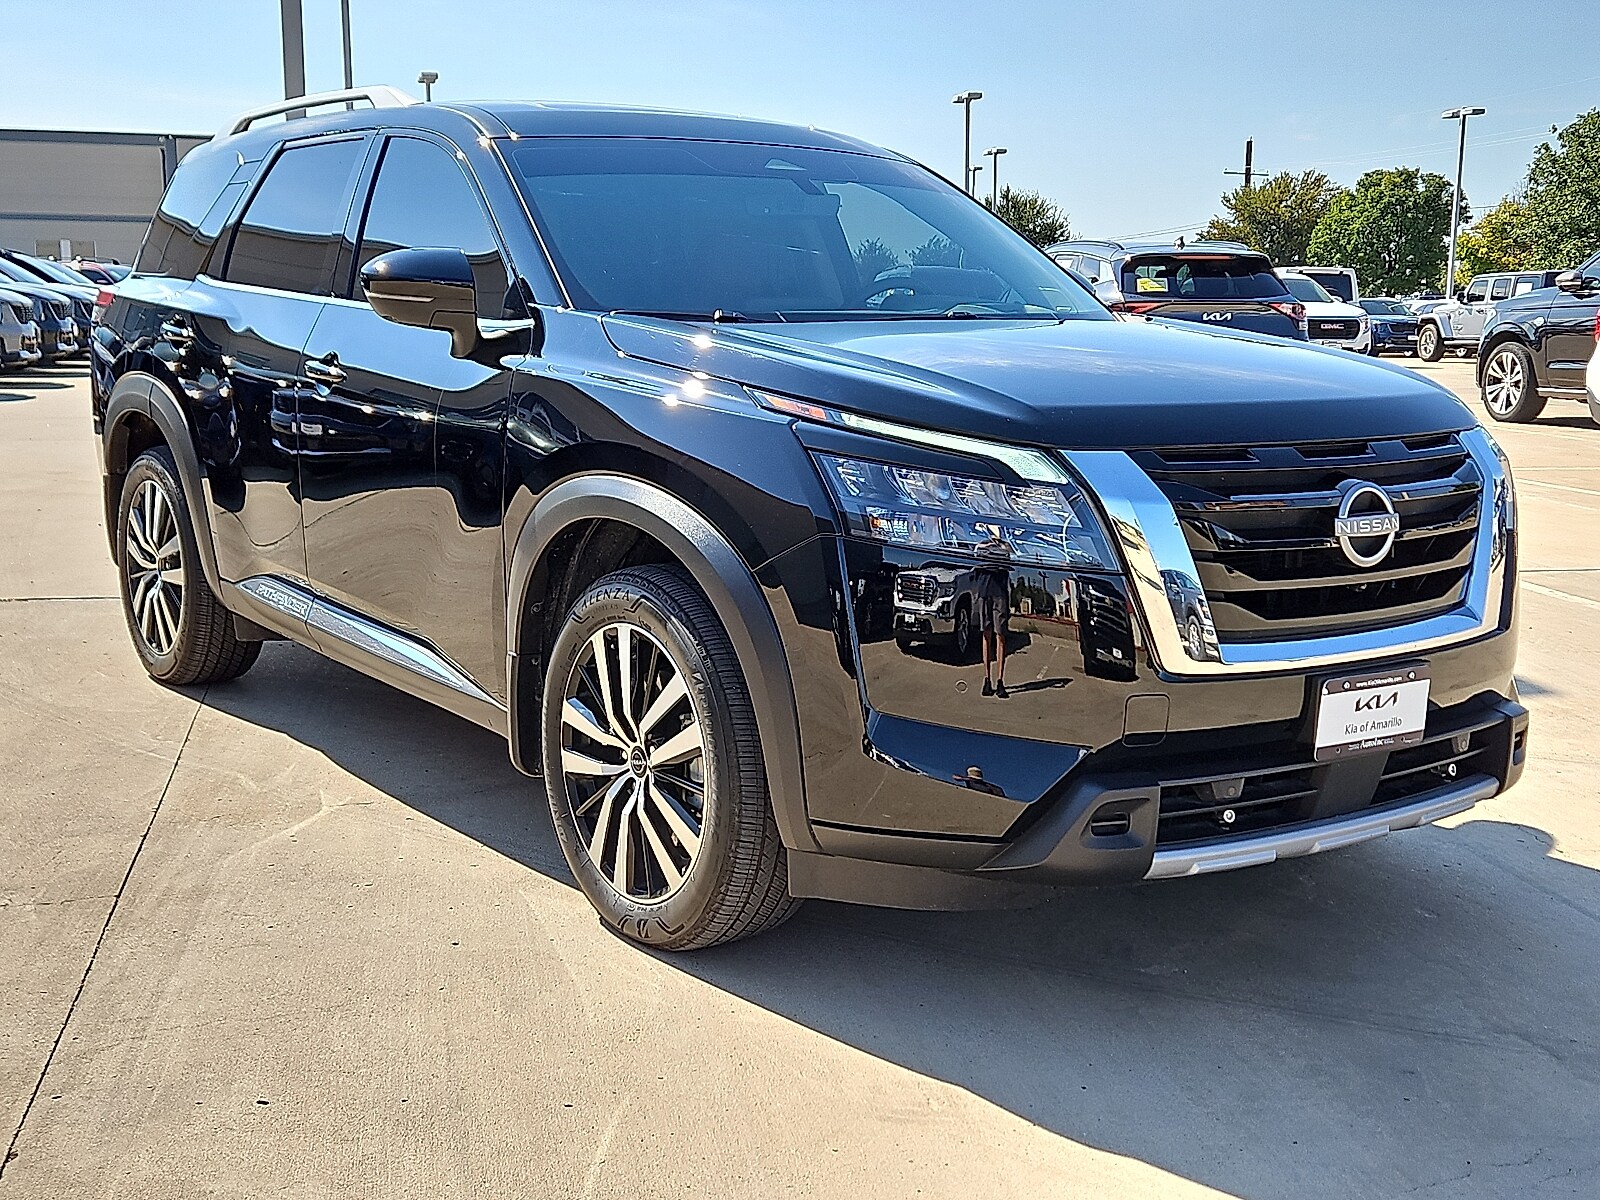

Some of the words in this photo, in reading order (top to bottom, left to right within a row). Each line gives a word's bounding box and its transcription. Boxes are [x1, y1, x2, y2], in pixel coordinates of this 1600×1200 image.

[1202, 312, 1232, 321] KIA
[1337, 517, 1399, 534] NISSAN
[1354, 690, 1399, 712] KIA
[1344, 723, 1358, 735] Kia
[1359, 720, 1370, 732] of
[1370, 717, 1403, 731] Amarillo
